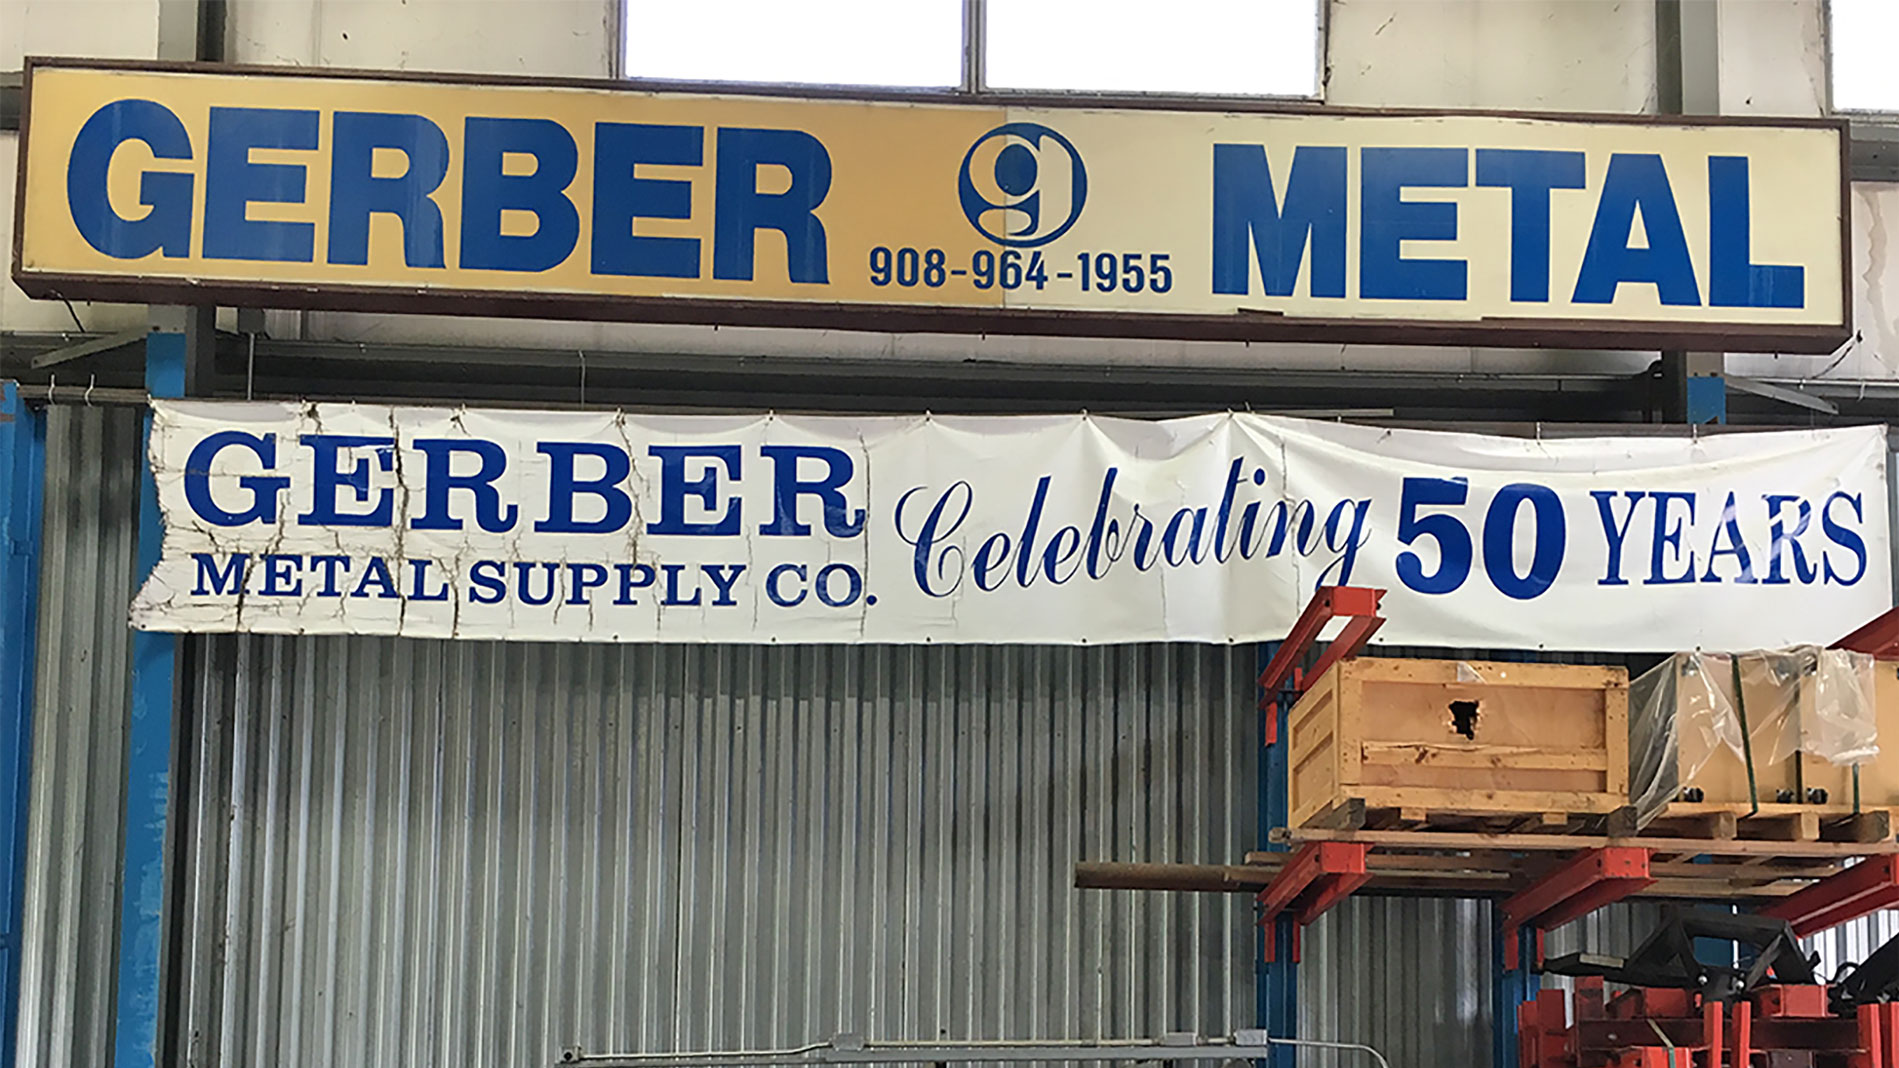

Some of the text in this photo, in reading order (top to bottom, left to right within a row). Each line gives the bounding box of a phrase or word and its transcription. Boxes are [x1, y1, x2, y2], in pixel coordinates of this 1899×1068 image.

[67, 99, 832, 284] GERBER
[1212, 143, 1805, 309] METAL
[870, 246, 1172, 293] 908-964-1955
[184, 431, 866, 537] GERBER
[894, 457, 1867, 600] Celebrating 50 YEARS
[191, 553, 877, 607] METAL SUPPLY CO.
